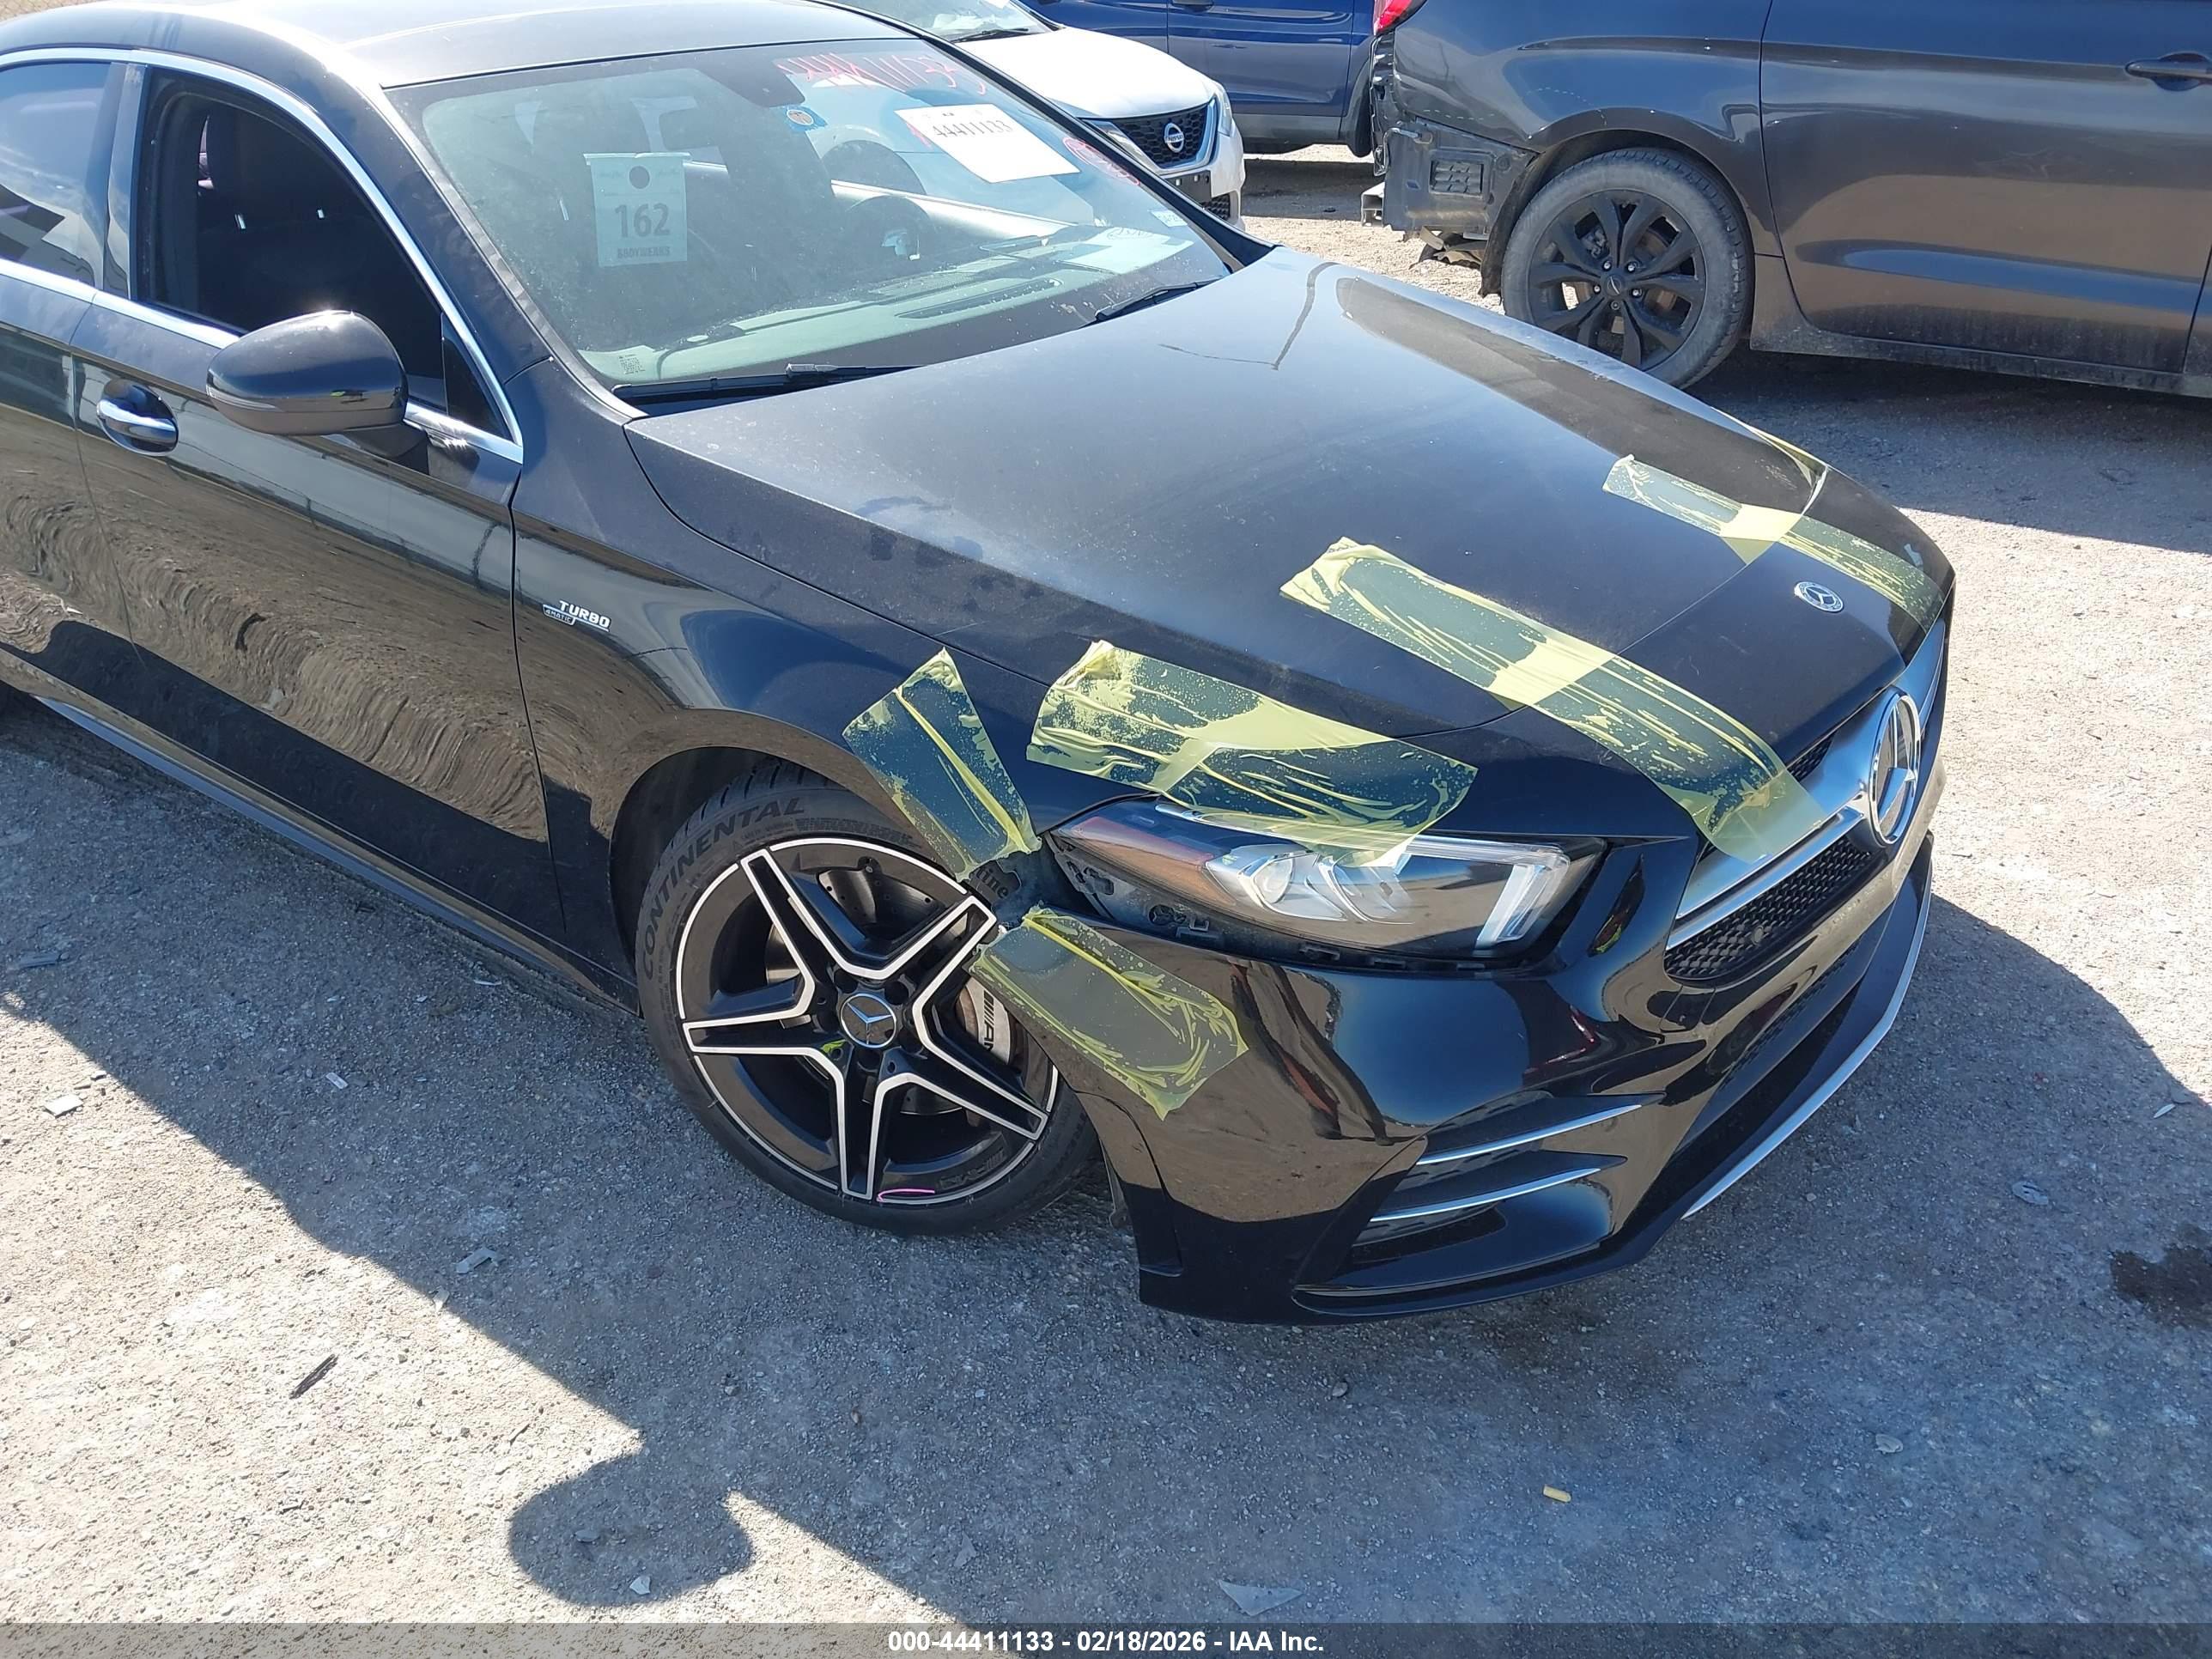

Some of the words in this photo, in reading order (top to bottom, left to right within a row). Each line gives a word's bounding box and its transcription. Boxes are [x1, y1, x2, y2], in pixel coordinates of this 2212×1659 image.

[933, 120, 1012, 137] 44411133
[615, 203, 671, 238] 162
[545, 609, 571, 623] 4MATIC
[559, 600, 611, 629] TURBO
[644, 797, 805, 981] CONTINENTAL
